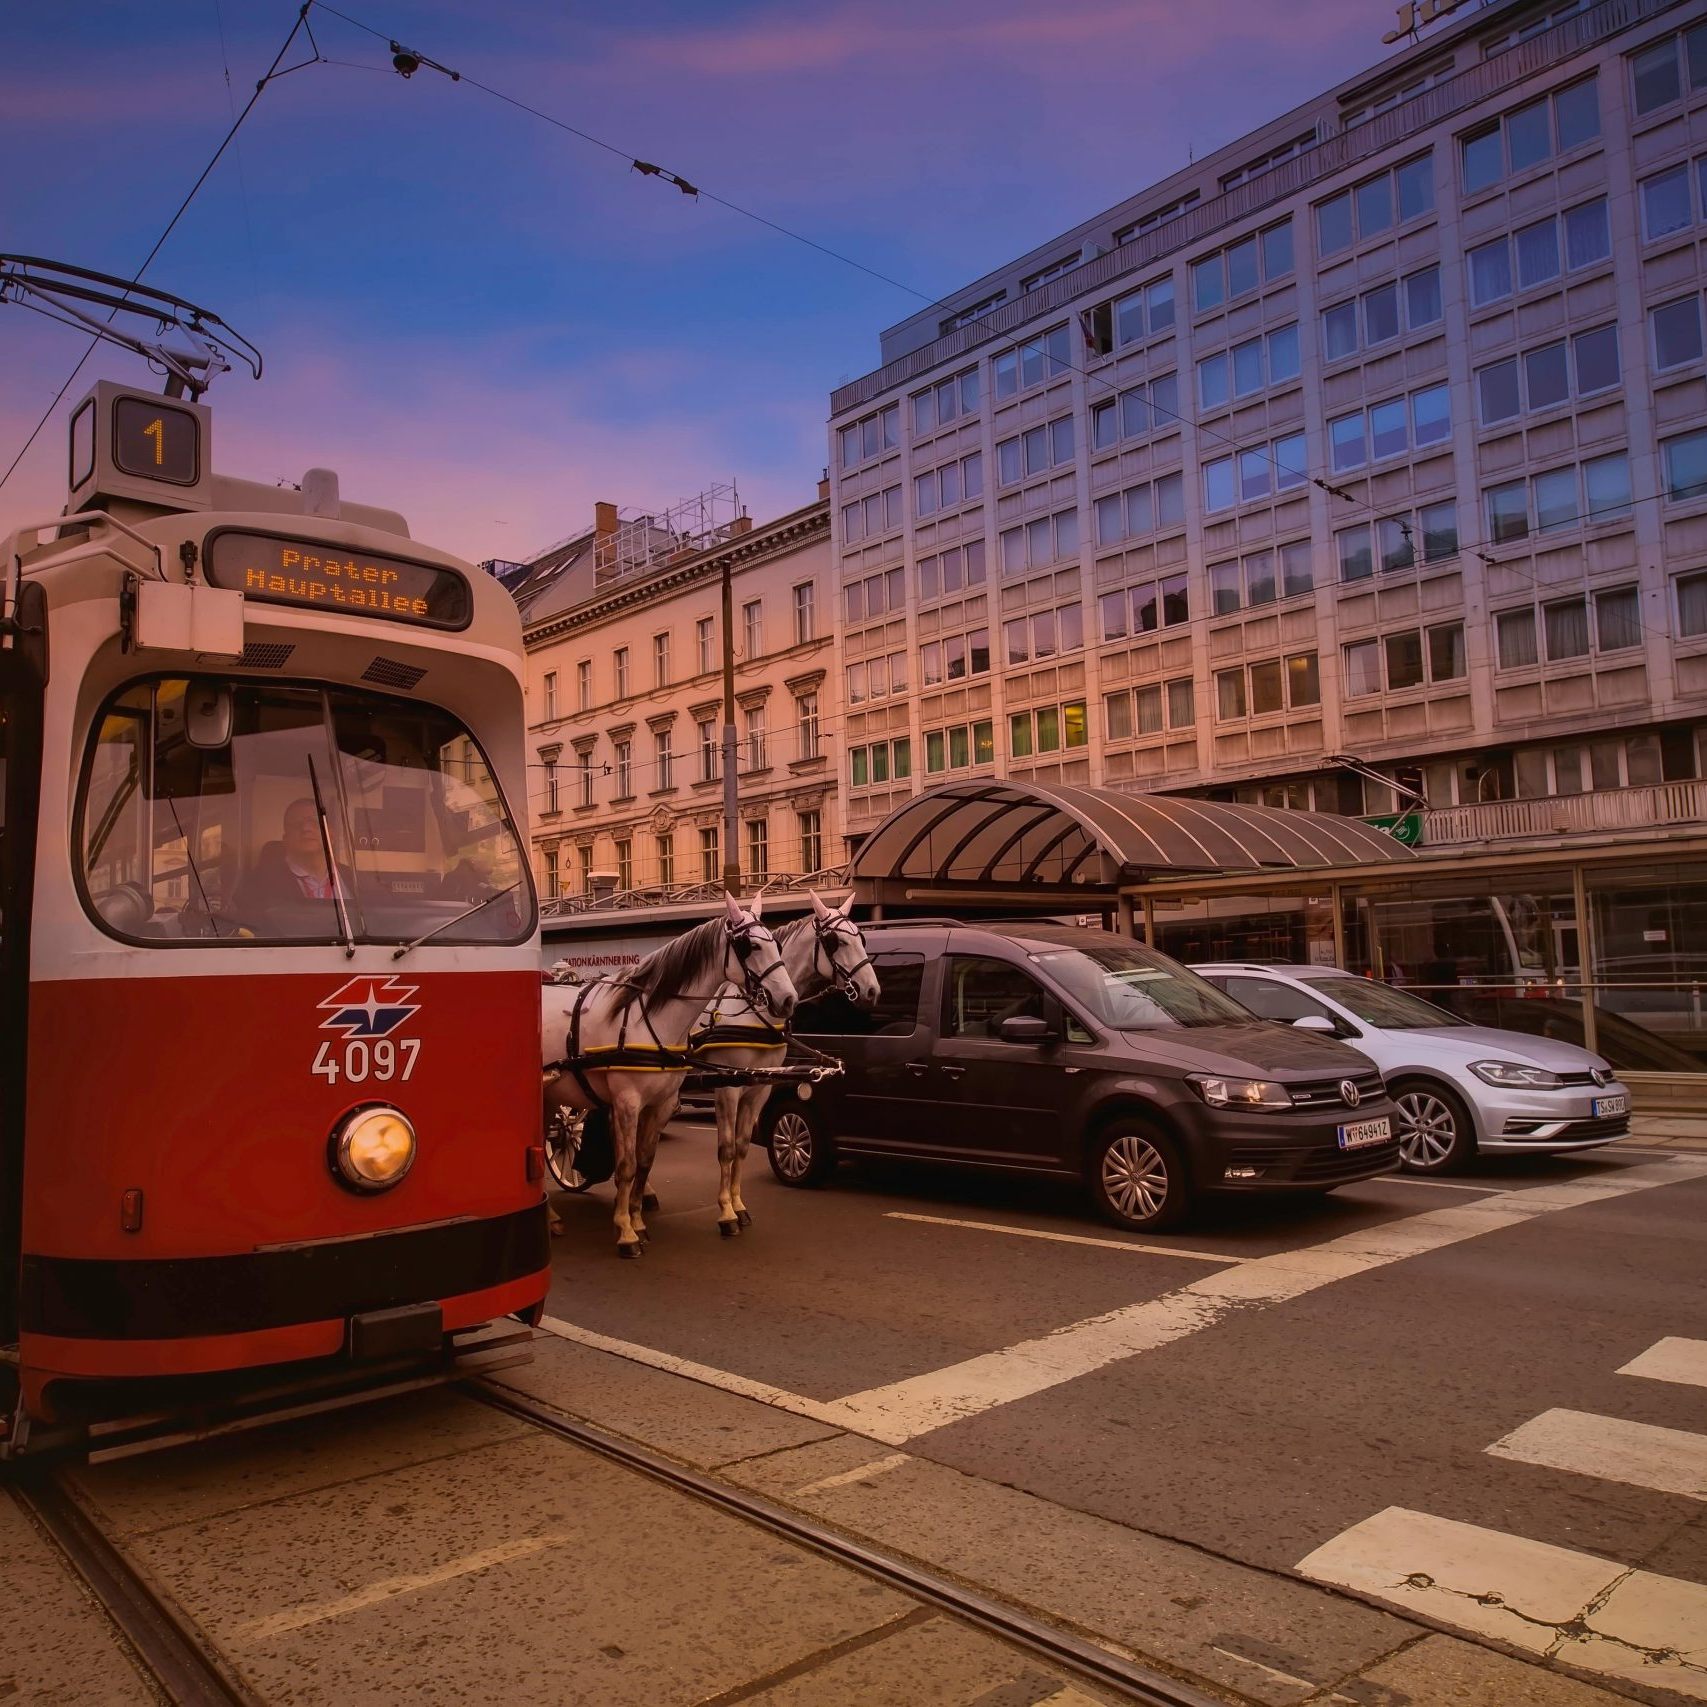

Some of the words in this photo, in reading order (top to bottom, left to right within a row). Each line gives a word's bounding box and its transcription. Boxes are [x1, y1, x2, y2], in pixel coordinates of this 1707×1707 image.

[143, 418, 164, 466] 1
[281, 548, 398, 584] Prater
[246, 568, 429, 615] Hauptallee
[588, 954, 622, 967] KÄRNTNER
[622, 954, 640, 966] RING
[311, 1037, 421, 1085] 4097
[1358, 1121, 1388, 1141] 64941Z
